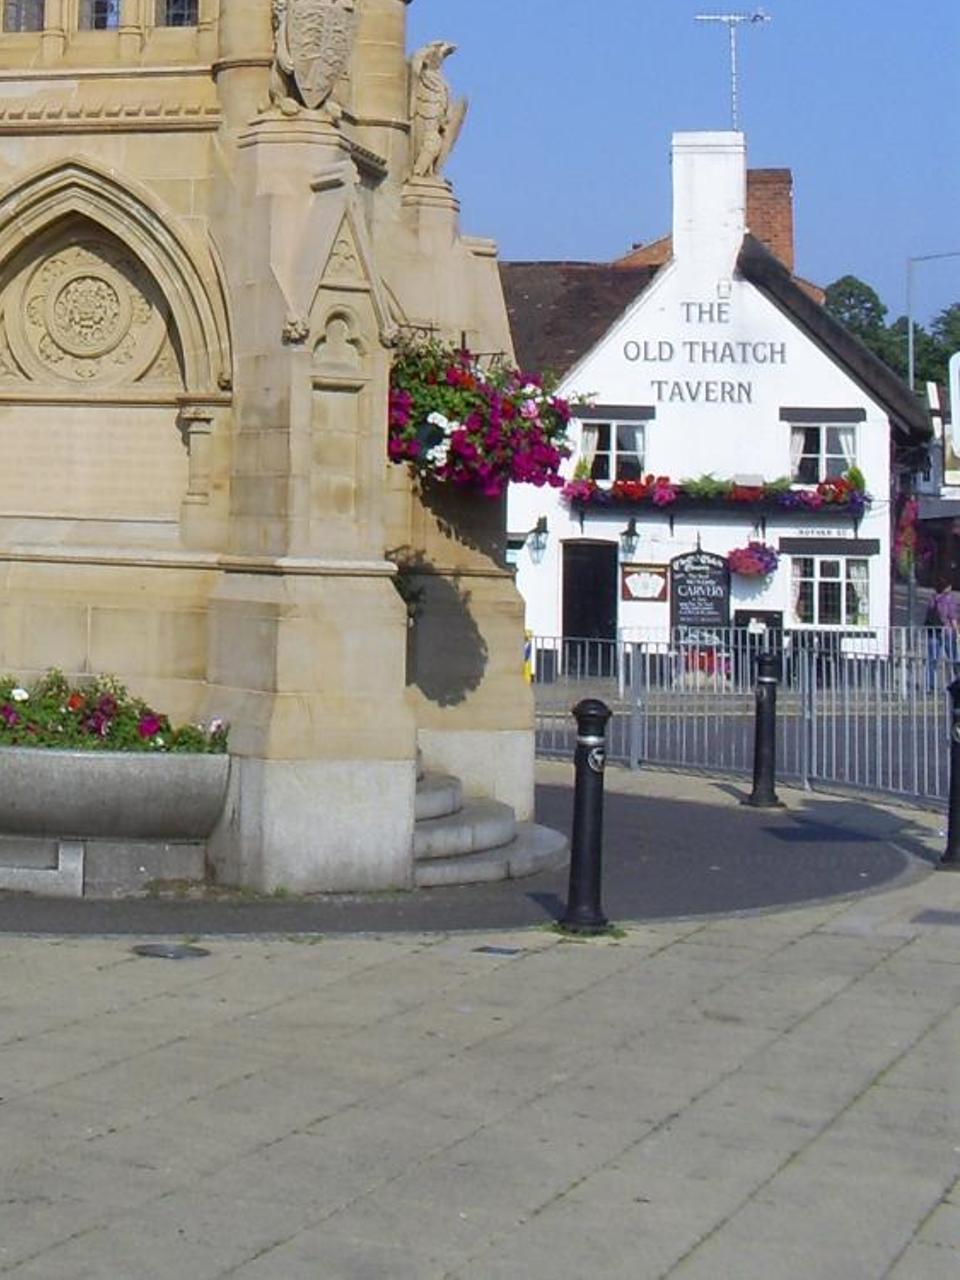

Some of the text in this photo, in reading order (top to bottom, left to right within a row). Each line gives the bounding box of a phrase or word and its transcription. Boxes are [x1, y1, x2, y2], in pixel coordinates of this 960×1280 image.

[681, 302, 730, 323] THE
[623, 340, 787, 364] OLD THATCH
[651, 381, 753, 403] TAVERN
